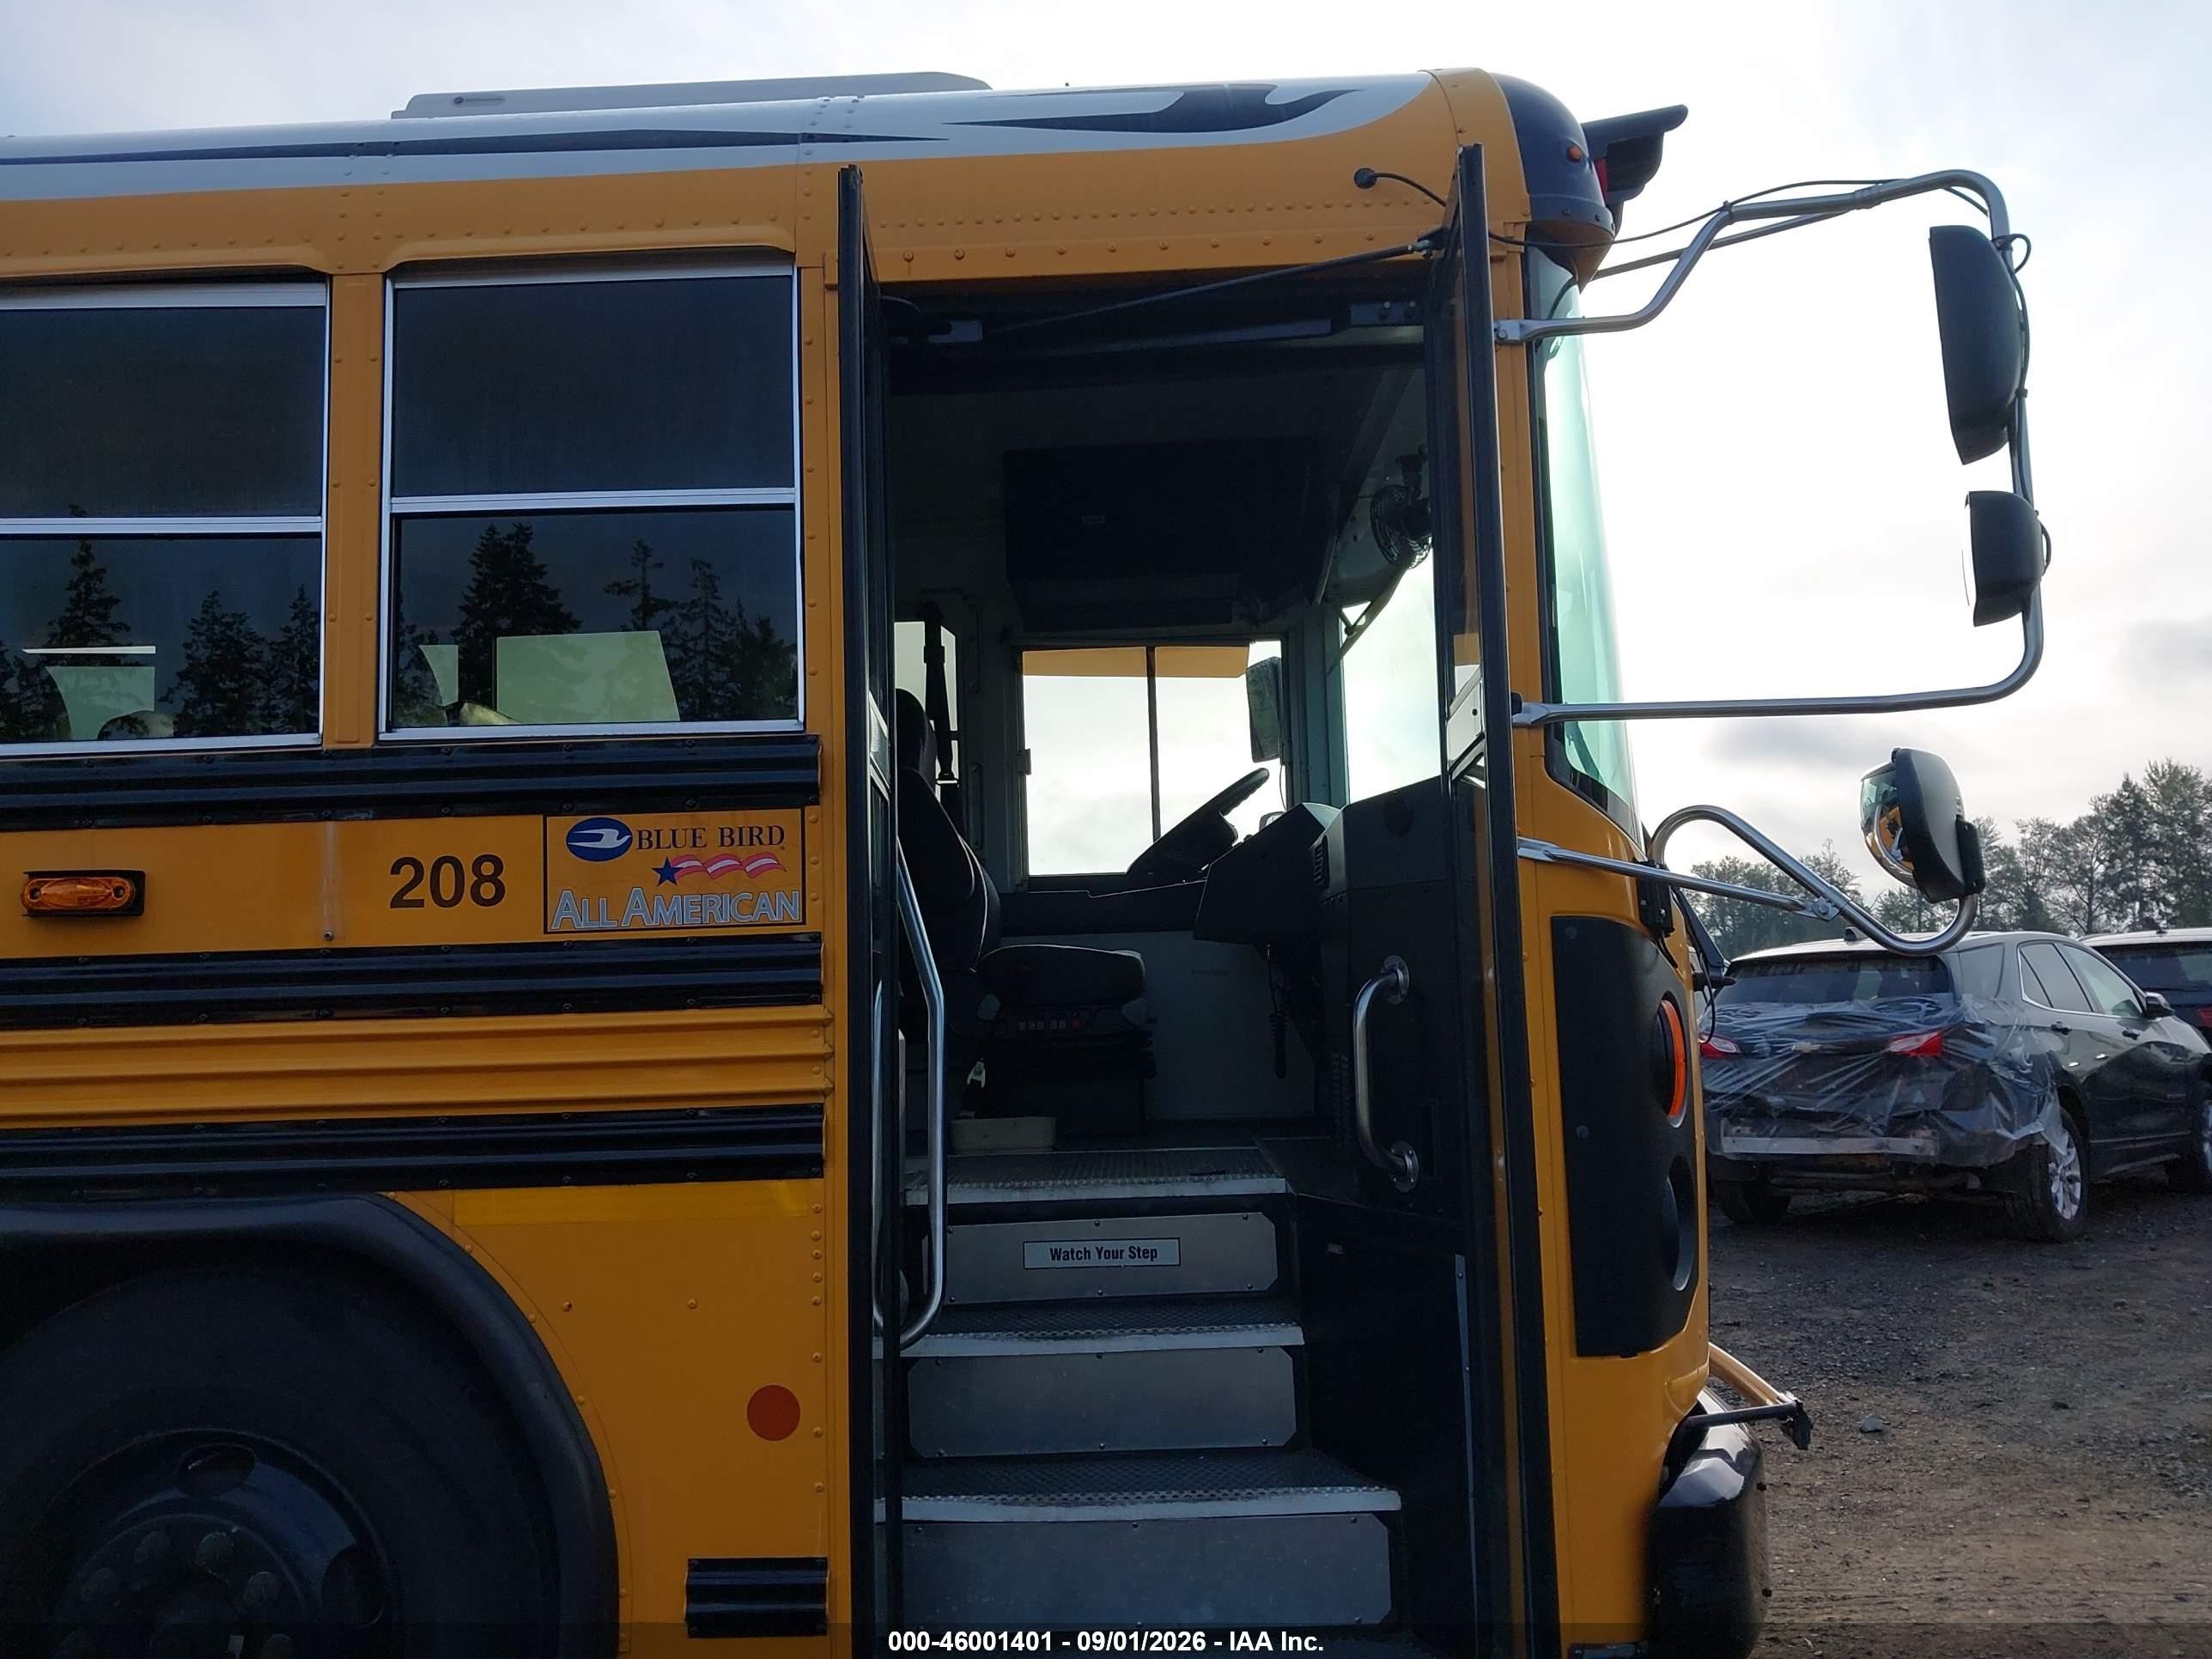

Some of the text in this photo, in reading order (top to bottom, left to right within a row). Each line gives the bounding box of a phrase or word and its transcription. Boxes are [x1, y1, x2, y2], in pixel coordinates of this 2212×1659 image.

[636, 824, 786, 850] BLUE BIRD
[390, 854, 506, 908] 208
[1049, 1245, 1158, 1262] Watch Your Step
